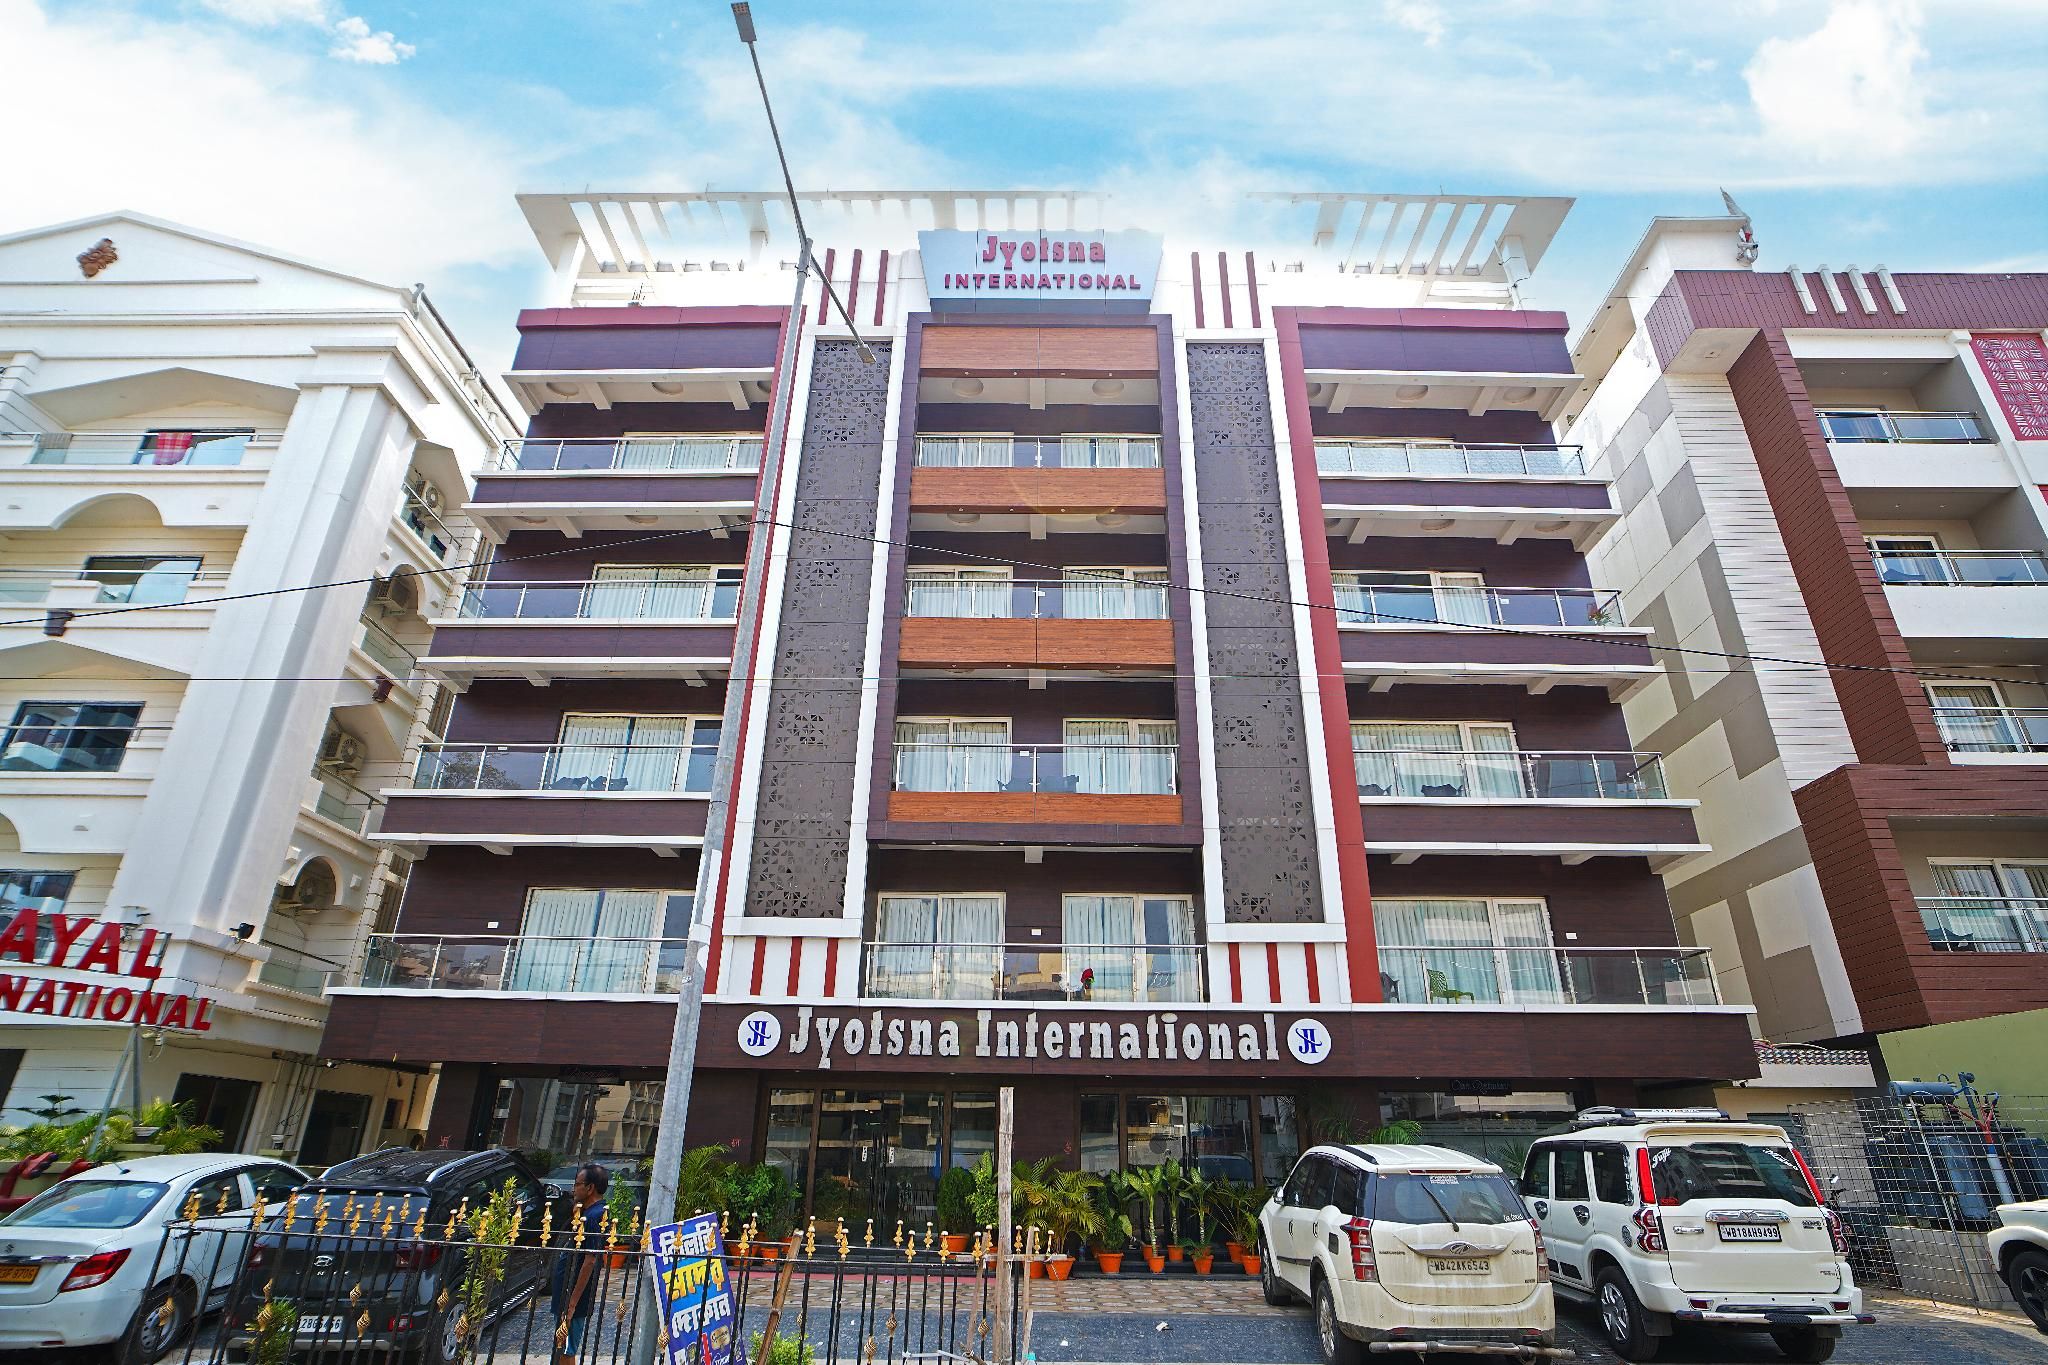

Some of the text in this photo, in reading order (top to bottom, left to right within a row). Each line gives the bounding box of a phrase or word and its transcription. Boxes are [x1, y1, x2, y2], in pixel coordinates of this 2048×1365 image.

[982, 235, 1106, 270] Jyotsna
[944, 273, 1141, 290] INTERNATIONAL
[789, 1007, 1280, 1069] Jyotsna International
